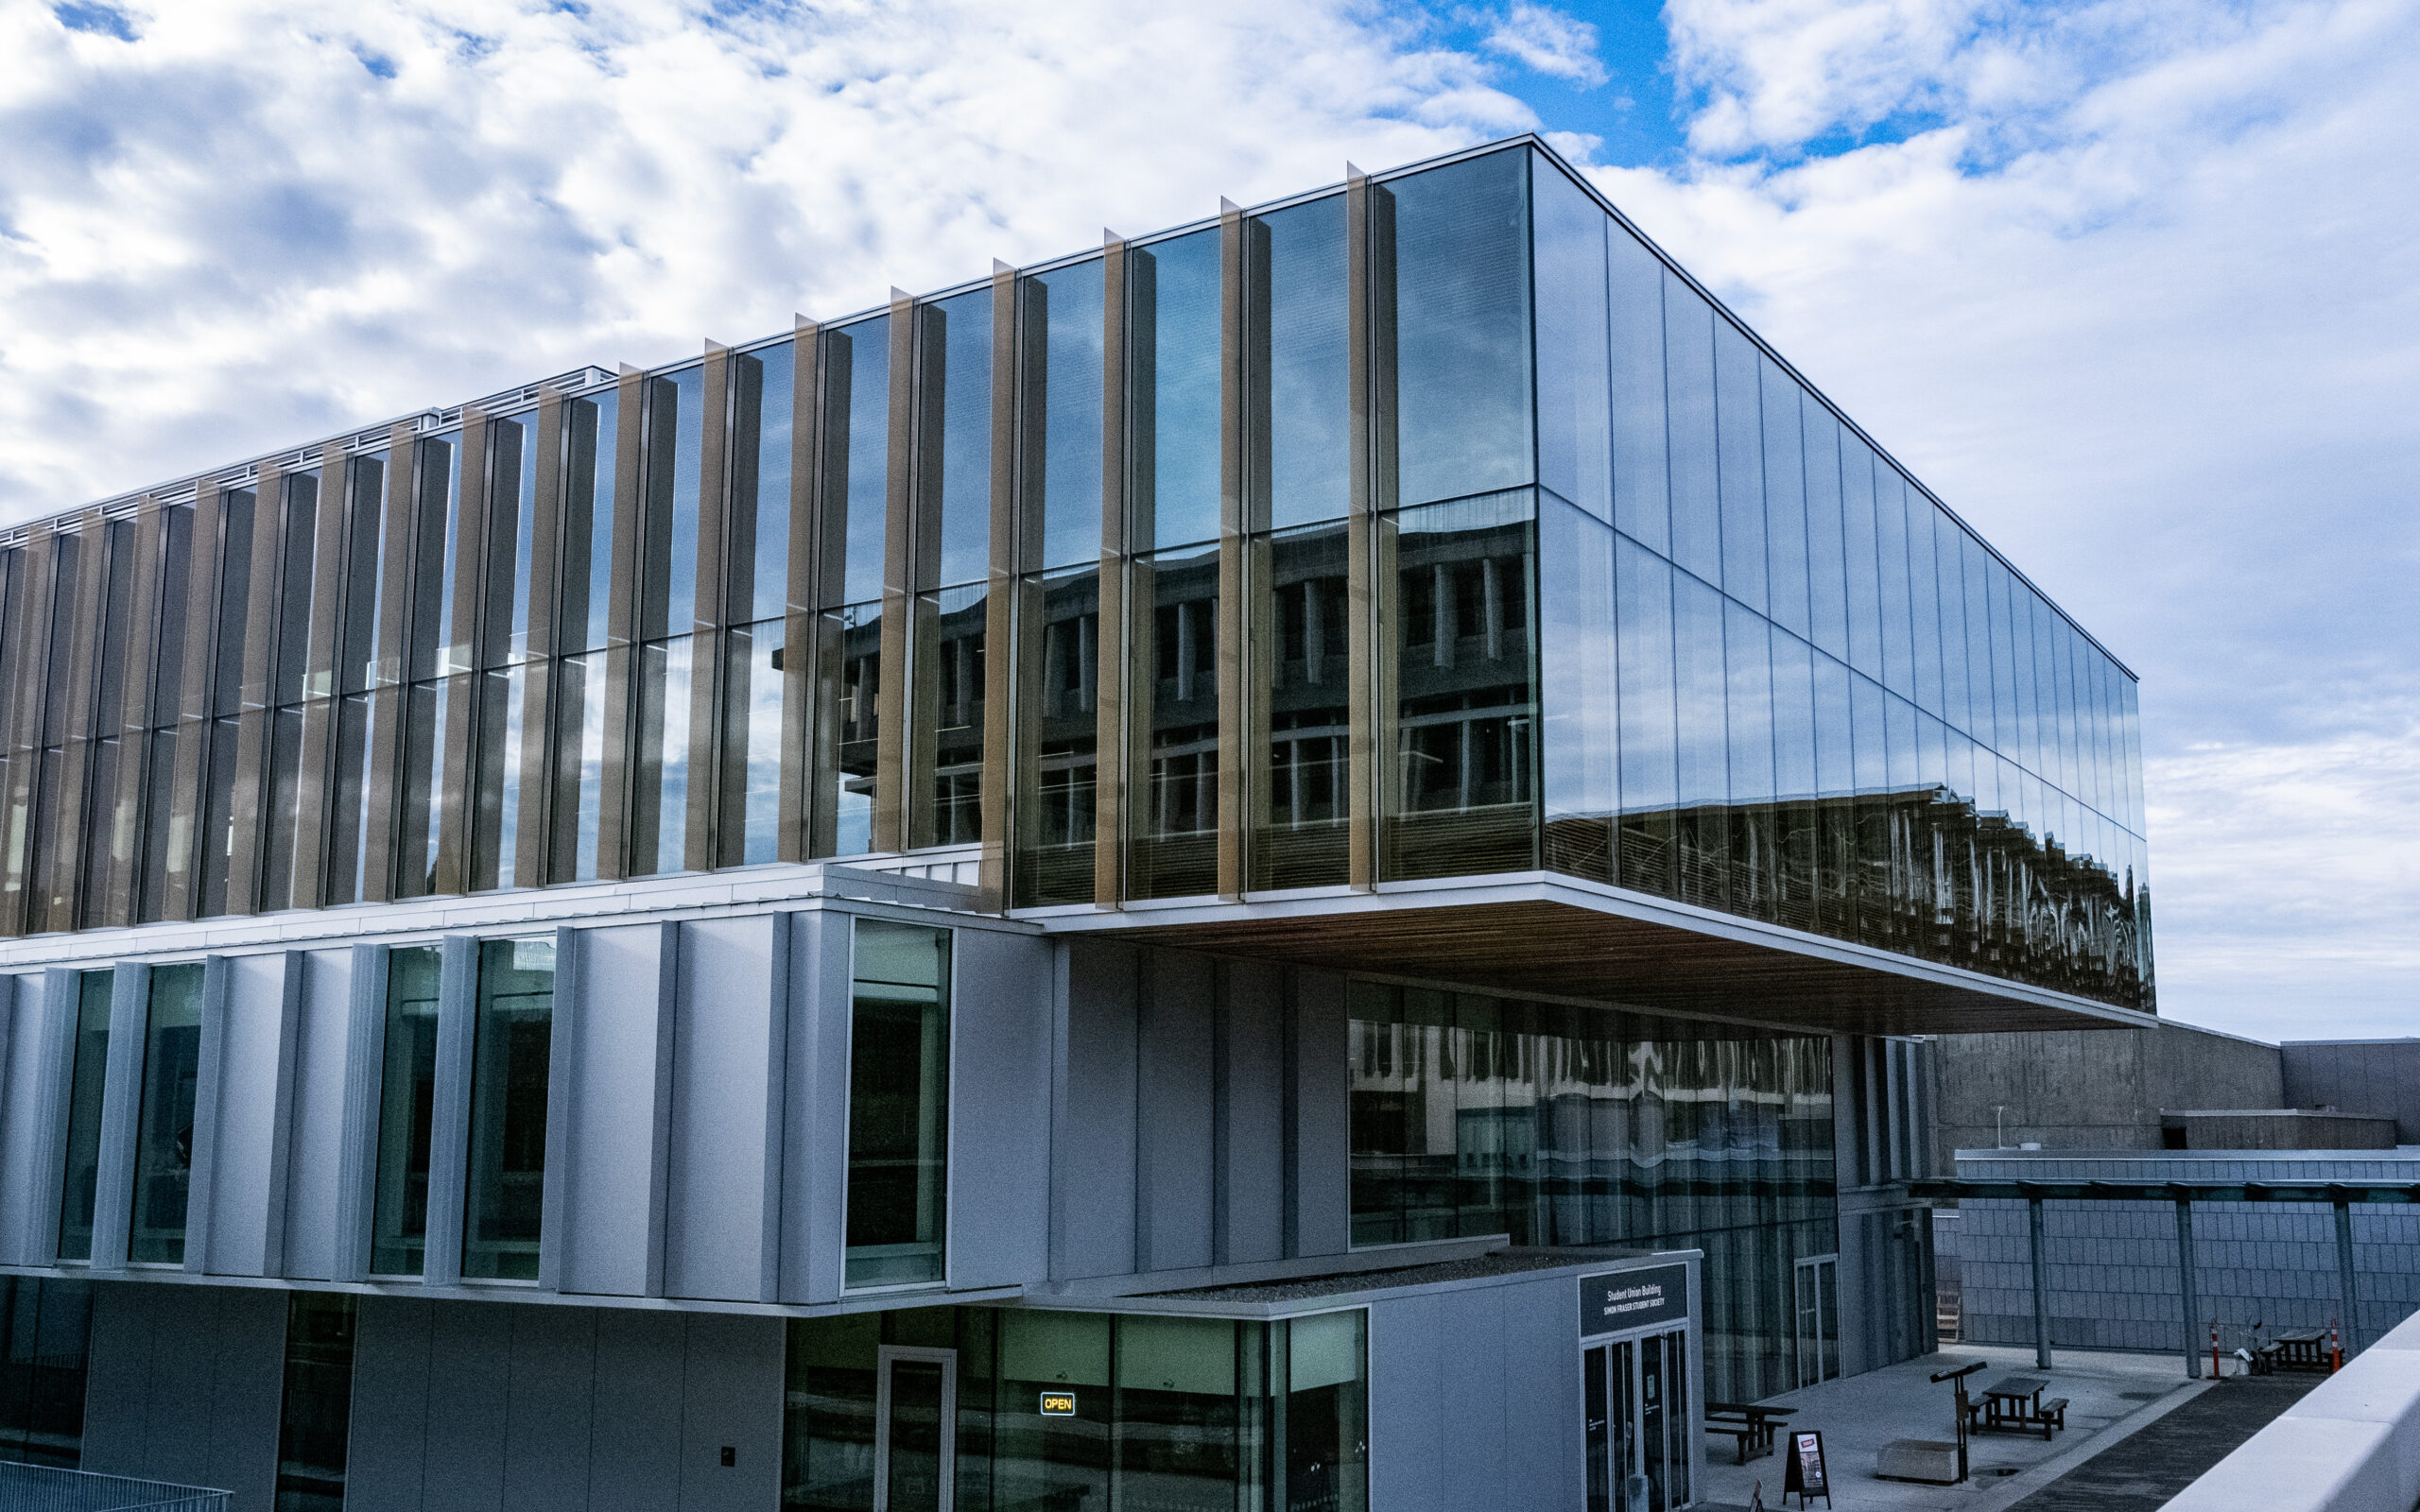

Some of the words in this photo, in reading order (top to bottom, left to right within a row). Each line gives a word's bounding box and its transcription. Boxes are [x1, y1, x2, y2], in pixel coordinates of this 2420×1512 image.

[1607, 1289, 1627, 1301] Student
[1627, 1287, 1642, 1298] Union
[1642, 1284, 1661, 1297] Building
[1603, 1306, 1616, 1315] SIMON
[1616, 1302, 1633, 1313] FRASER
[1633, 1300, 1649, 1311] STUDENT
[1650, 1297, 1665, 1307] SOCIETY
[1045, 1398, 1072, 1410] OPEN
